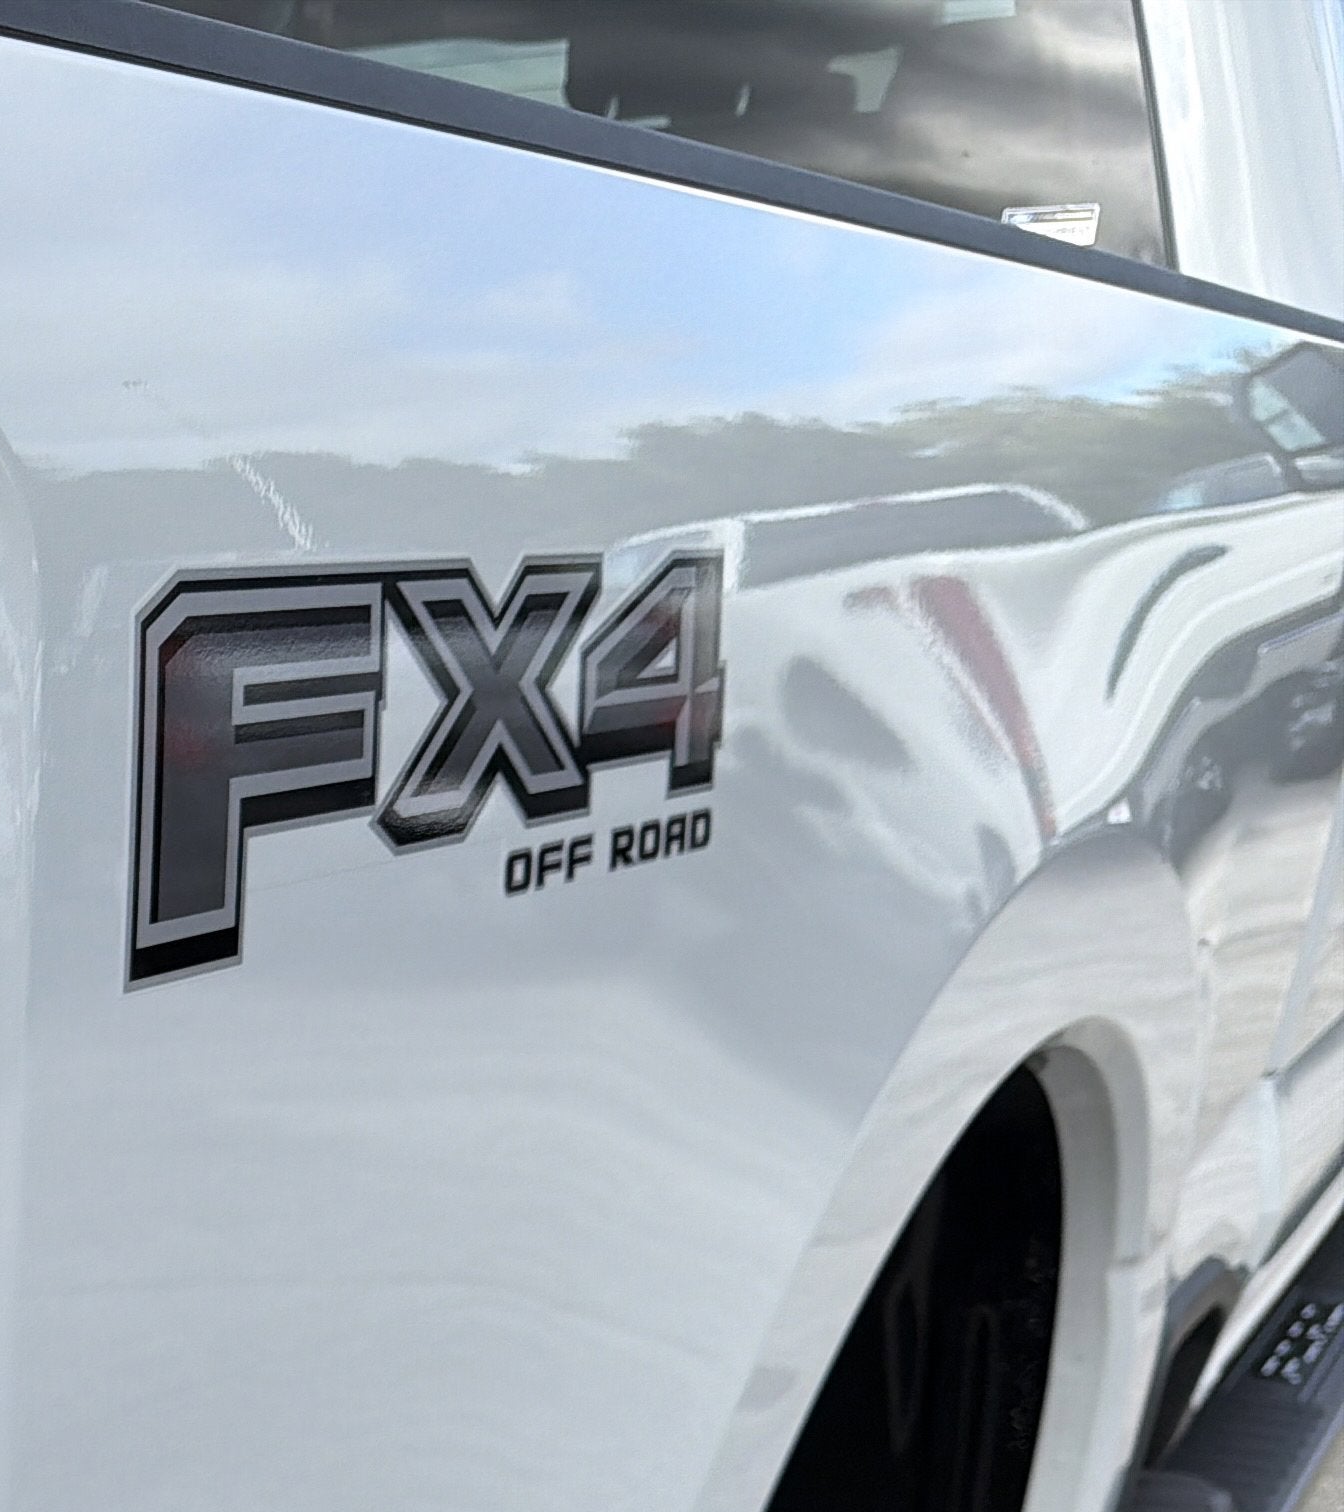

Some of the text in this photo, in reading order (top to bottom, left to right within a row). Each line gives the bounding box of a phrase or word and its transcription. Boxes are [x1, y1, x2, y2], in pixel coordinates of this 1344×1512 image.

[123, 550, 726, 992] FX4
[504, 809, 712, 896] OFF ROAD
